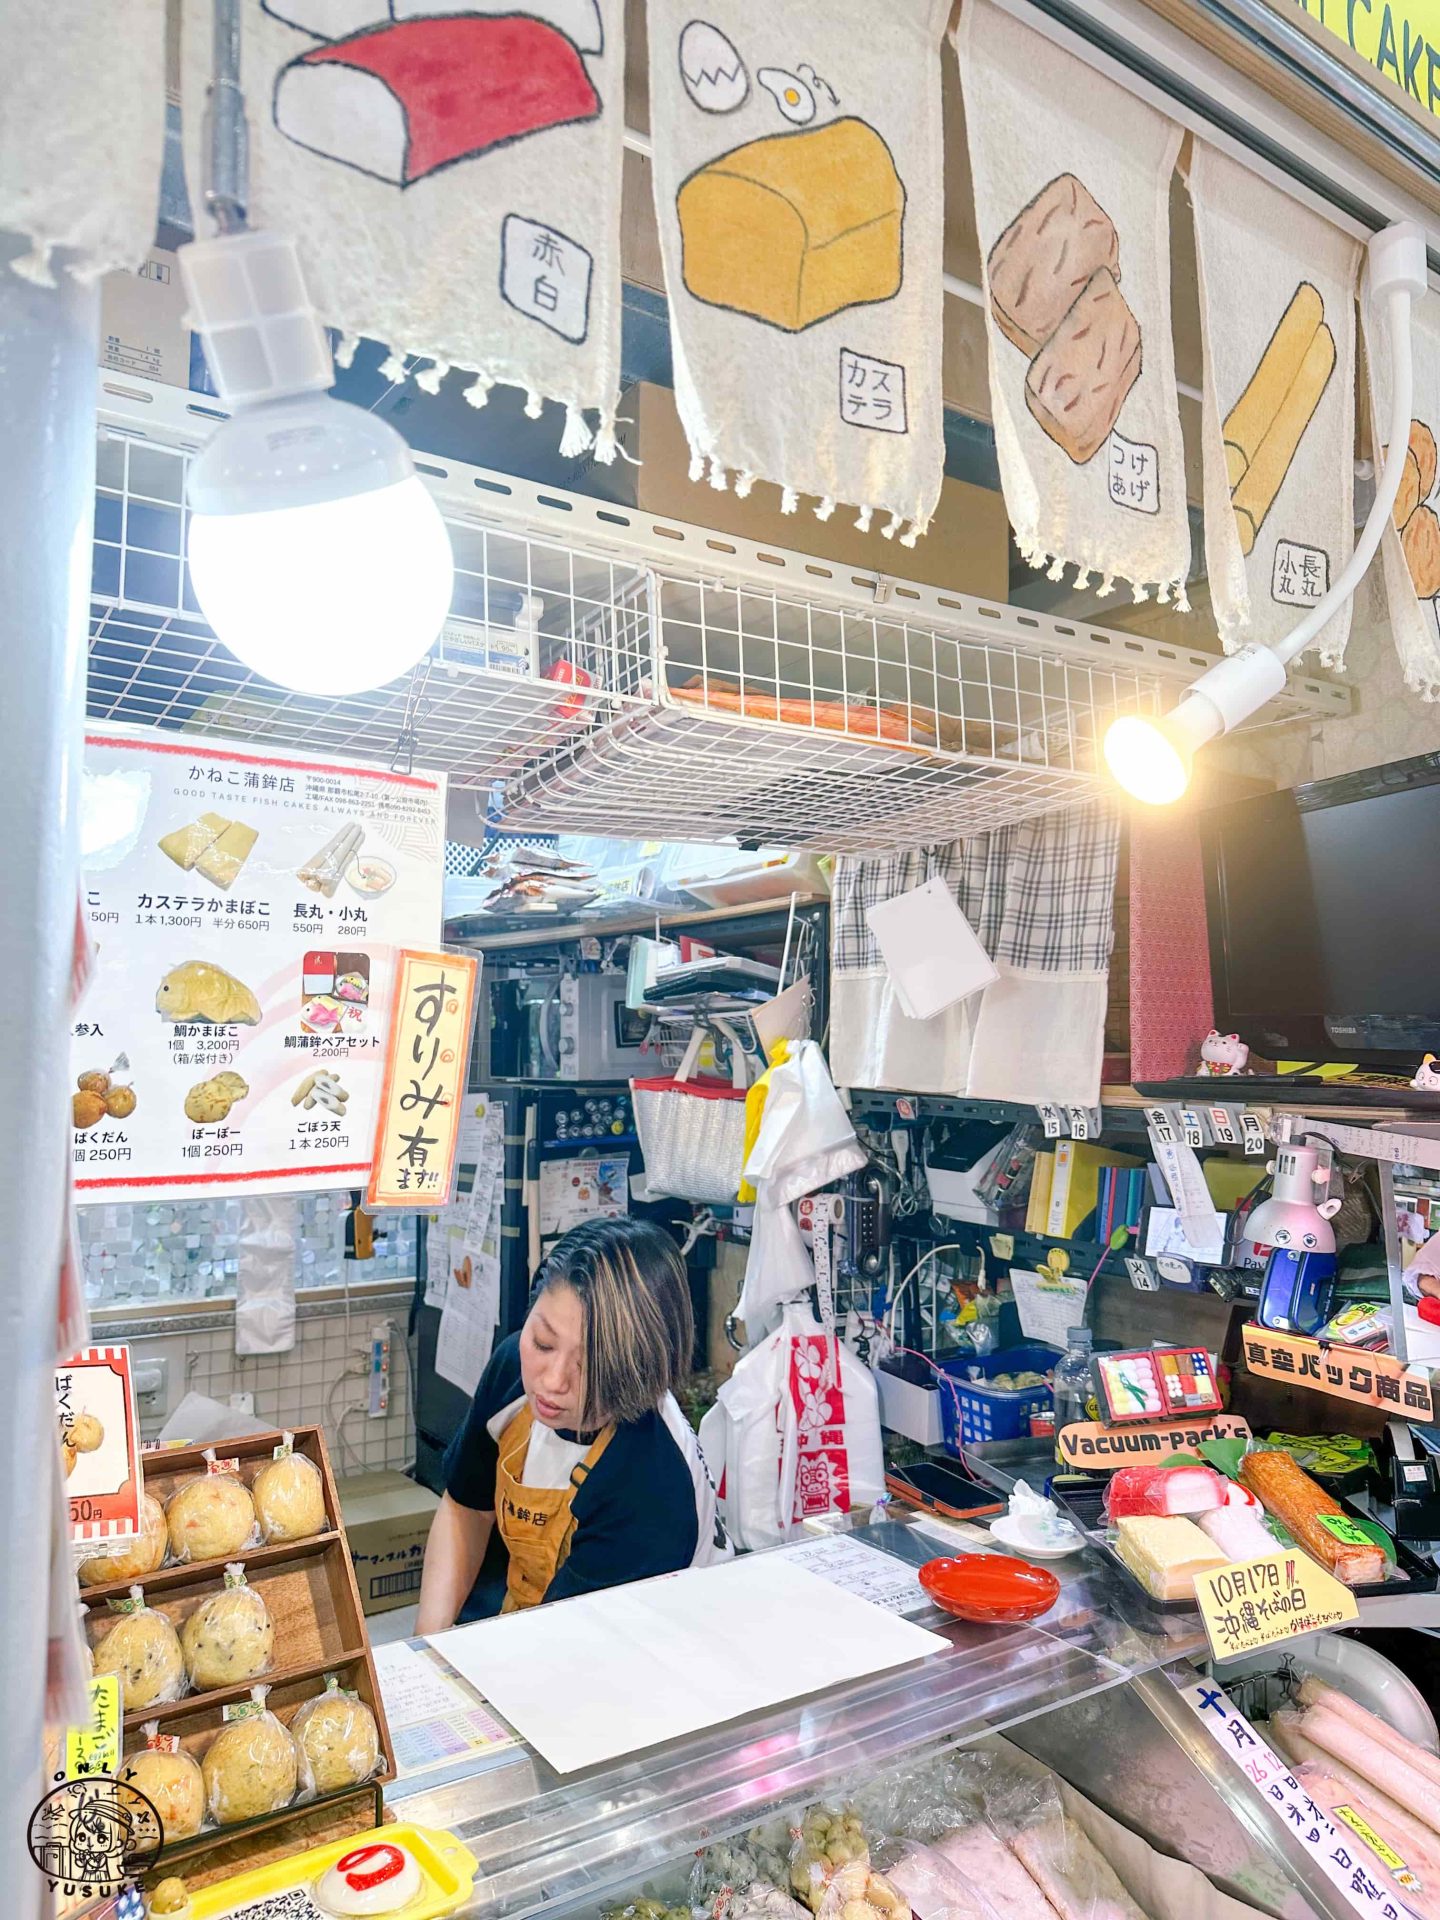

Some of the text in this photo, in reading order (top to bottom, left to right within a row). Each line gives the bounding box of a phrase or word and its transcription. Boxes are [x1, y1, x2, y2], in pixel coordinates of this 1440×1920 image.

[532, 233, 565, 312] 赤白
[847, 360, 891, 393] カス
[847, 393, 892, 420] テラ
[1112, 444, 1148, 475] つけ
[1112, 472, 1151, 502] あげ
[1278, 550, 1297, 595] 小丸
[1299, 554, 1322, 597] 長丸
[188, 765, 296, 793] かねこ蒲鉾店
[173, 787, 436, 825] GOOD TASTE FISH CAKES ALWAYS AND FOREVER
[137, 893, 271, 916] カステラかまぼこ
[88, 911, 119, 923] 50円
[293, 903, 368, 922] 長丸・小丸
[159, 915, 202, 928] 1,300円
[212, 917, 235, 930] 半分
[237, 919, 270, 931] 650円
[292, 923, 323, 934] 550円
[337, 925, 366, 936] 280円
[71, 1023, 104, 1037] 参入
[173, 1024, 239, 1037] 鯛かまぼこ
[1330, 1026, 1357, 1034] TOSHIBA
[168, 1040, 240, 1051] 1個 3,200円
[284, 1035, 380, 1049] 鯛蒲鉾ペアセット
[312, 1047, 349, 1058] 2,200円
[1041, 1105, 1056, 1118] 水
[1151, 1110, 1167, 1124] 金
[1212, 1109, 1227, 1124] 日
[297, 1120, 341, 1133] ごぼう天
[1183, 1112, 1198, 1127] 土
[1243, 1117, 1259, 1132] 月
[1047, 1122, 1057, 1134] 15
[1074, 1123, 1085, 1137] 16
[1158, 1127, 1171, 1141] 17
[1217, 1128, 1233, 1142] 19
[74, 1131, 128, 1144] ばくだん
[314, 1135, 349, 1149] 250円
[1186, 1130, 1200, 1145] 18
[1246, 1137, 1263, 1152] 20
[89, 1147, 132, 1161] 250円
[181, 1143, 243, 1158] 1個 250円
[1131, 1261, 1145, 1274] 火
[1137, 1277, 1149, 1288] 14
[1245, 1342, 1431, 1411] 真空パック商品
[55, 1375, 77, 1448] ばくだん
[1062, 1424, 1247, 1456] Vacuum-pack's
[1209, 1563, 1280, 1607] 10月17日
[1213, 1588, 1307, 1644] 沖縄そばの日
[1196, 1687, 1256, 1748] 十月
